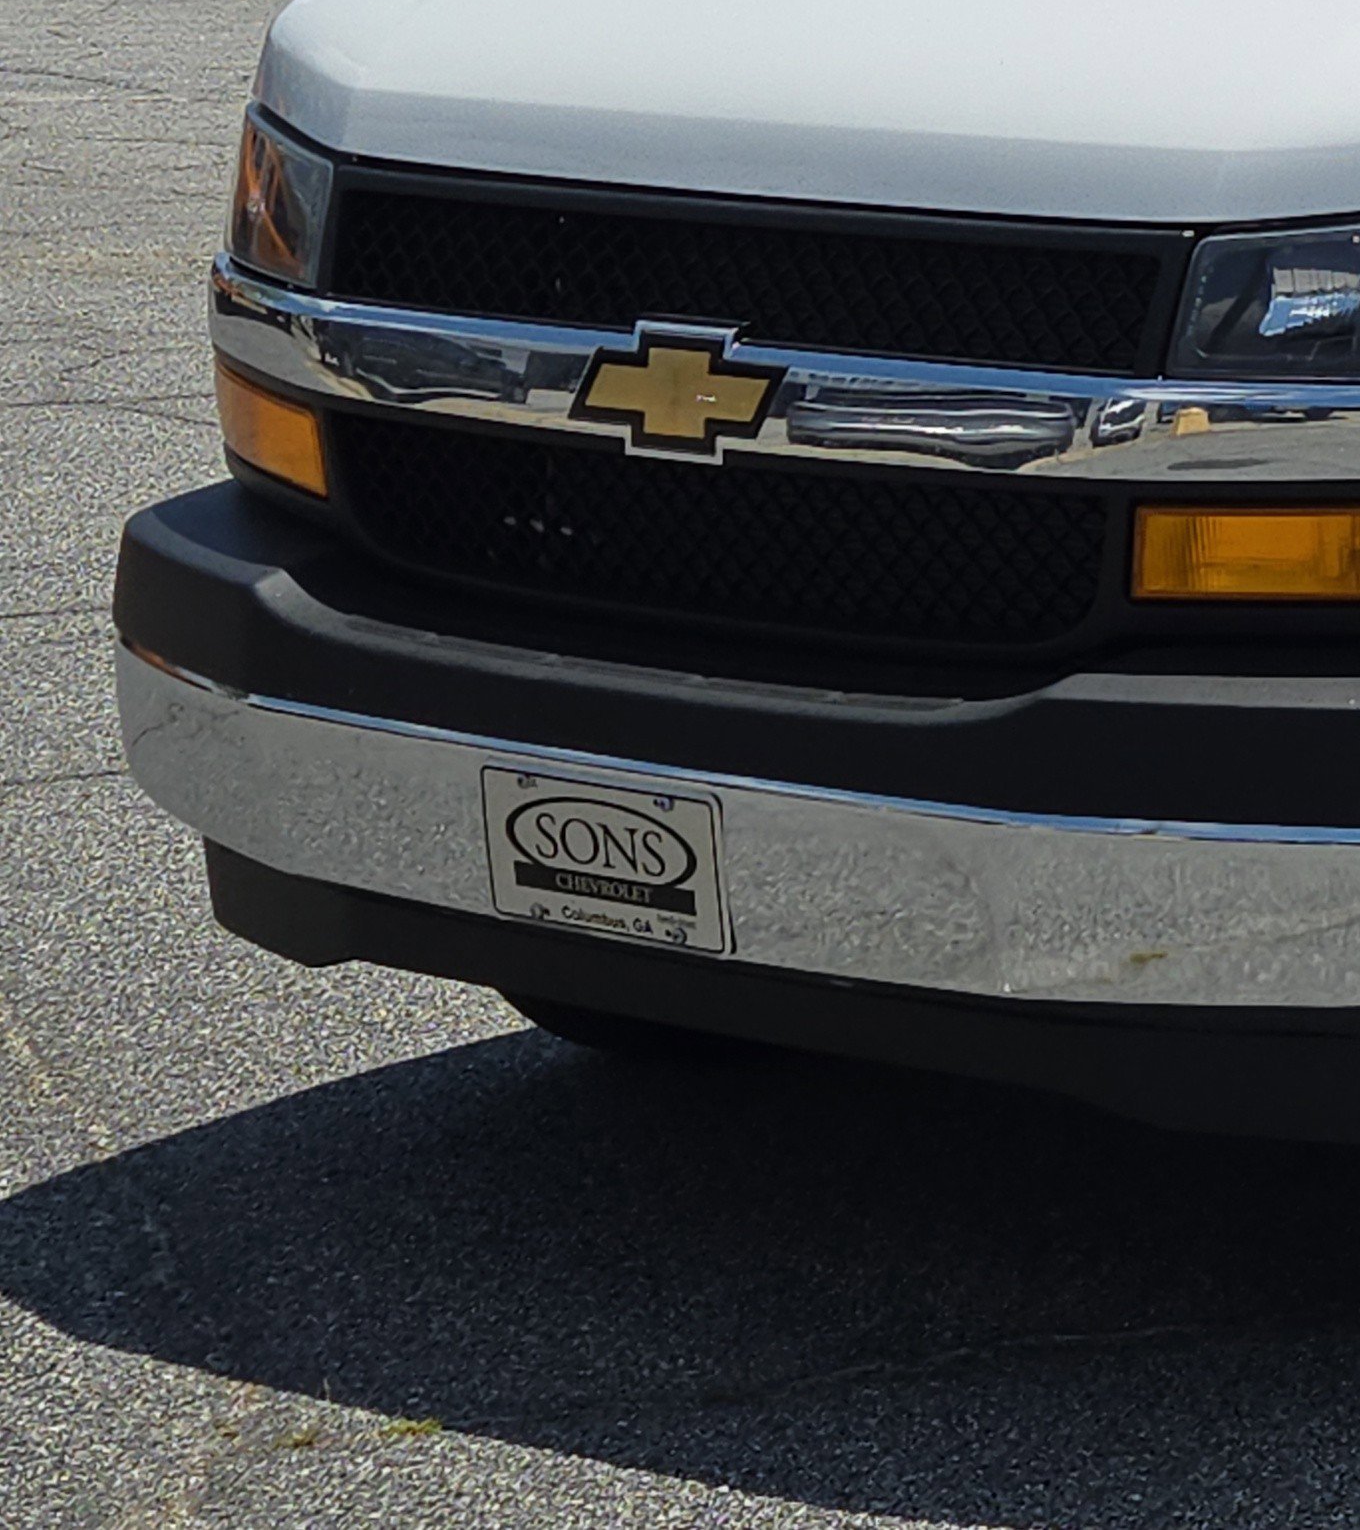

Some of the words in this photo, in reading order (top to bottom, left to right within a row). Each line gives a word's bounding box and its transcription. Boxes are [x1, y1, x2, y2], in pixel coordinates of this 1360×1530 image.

[534, 812, 666, 877] SONS
[555, 871, 653, 904] CHEVROLET
[632, 917, 654, 935] GA
